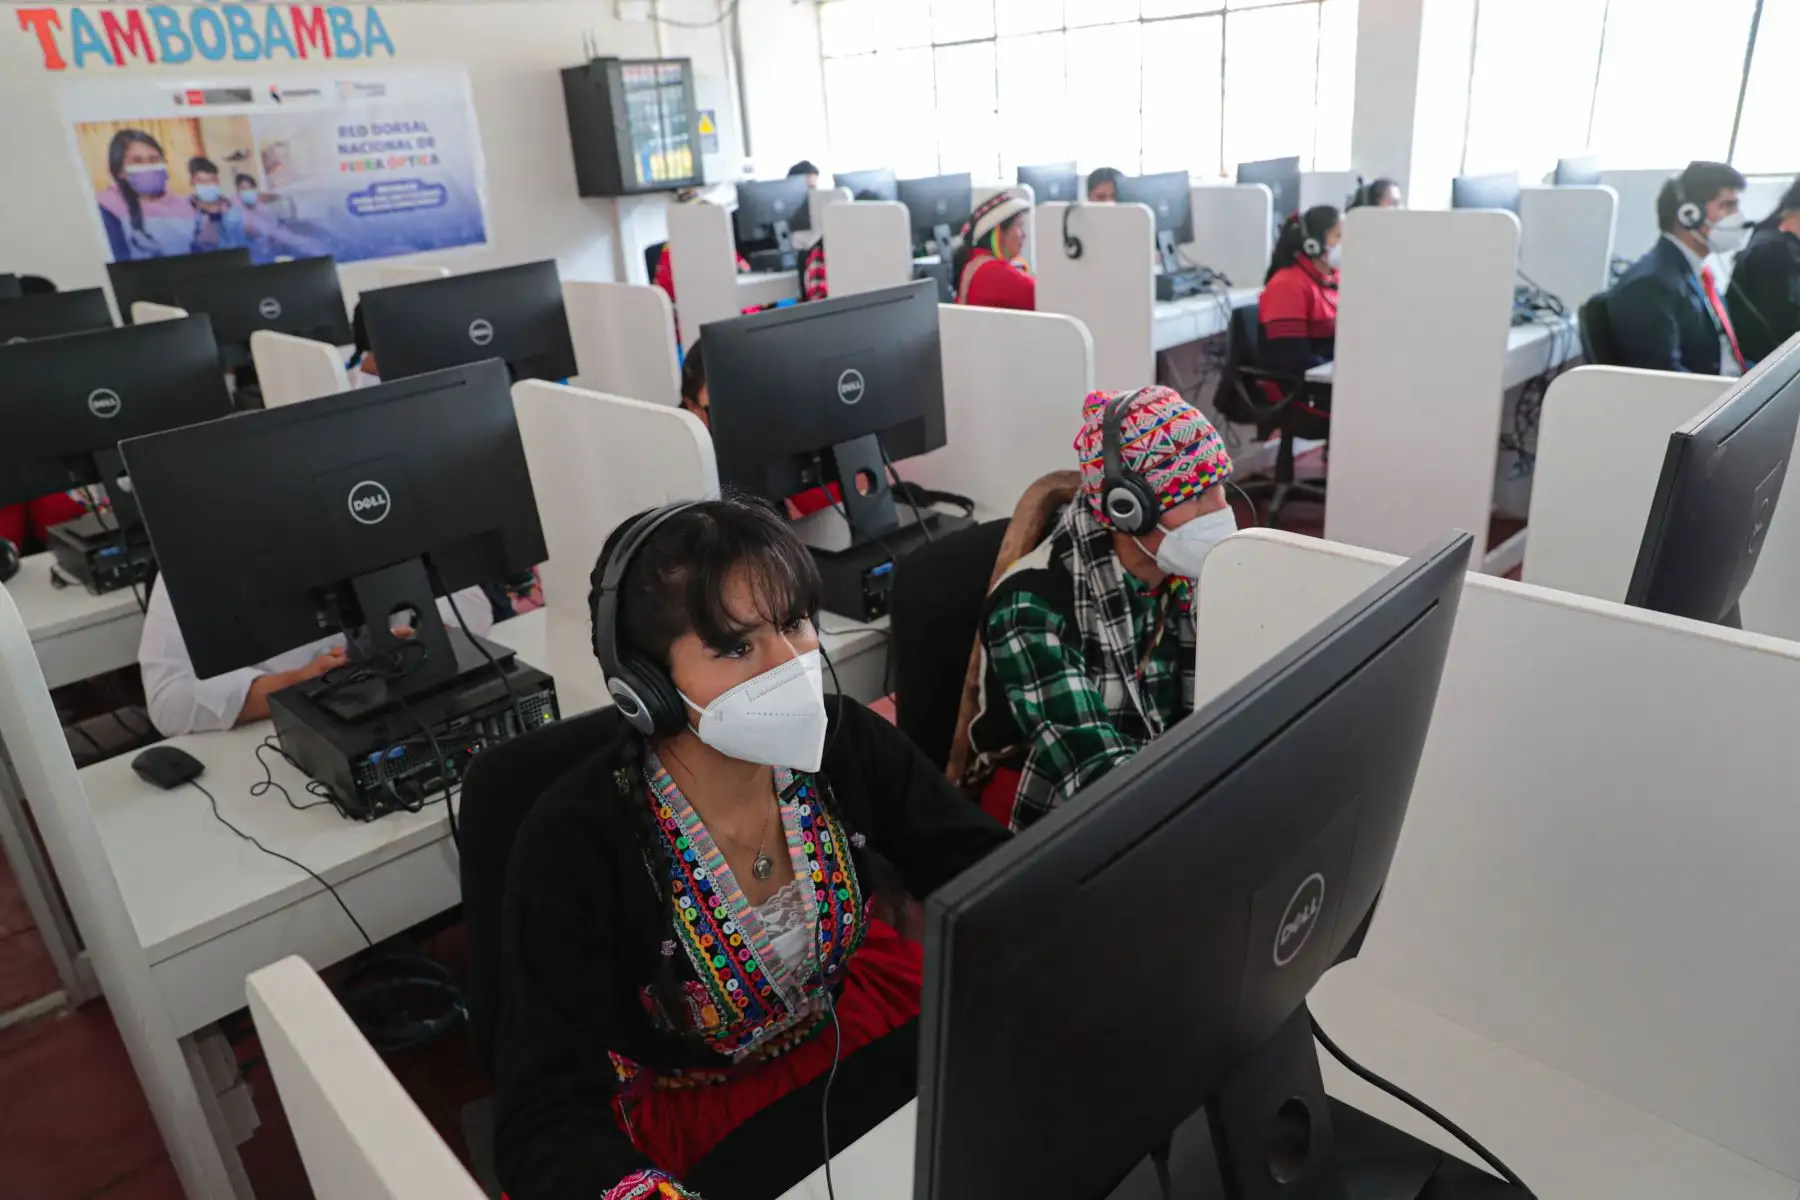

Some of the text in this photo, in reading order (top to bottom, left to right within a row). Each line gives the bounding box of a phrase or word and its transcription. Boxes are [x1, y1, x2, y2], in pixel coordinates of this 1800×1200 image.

[17, 6, 395, 71] TAMBOBAMBA
[353, 494, 386, 511] DELL
[1280, 898, 1317, 946] DELL
